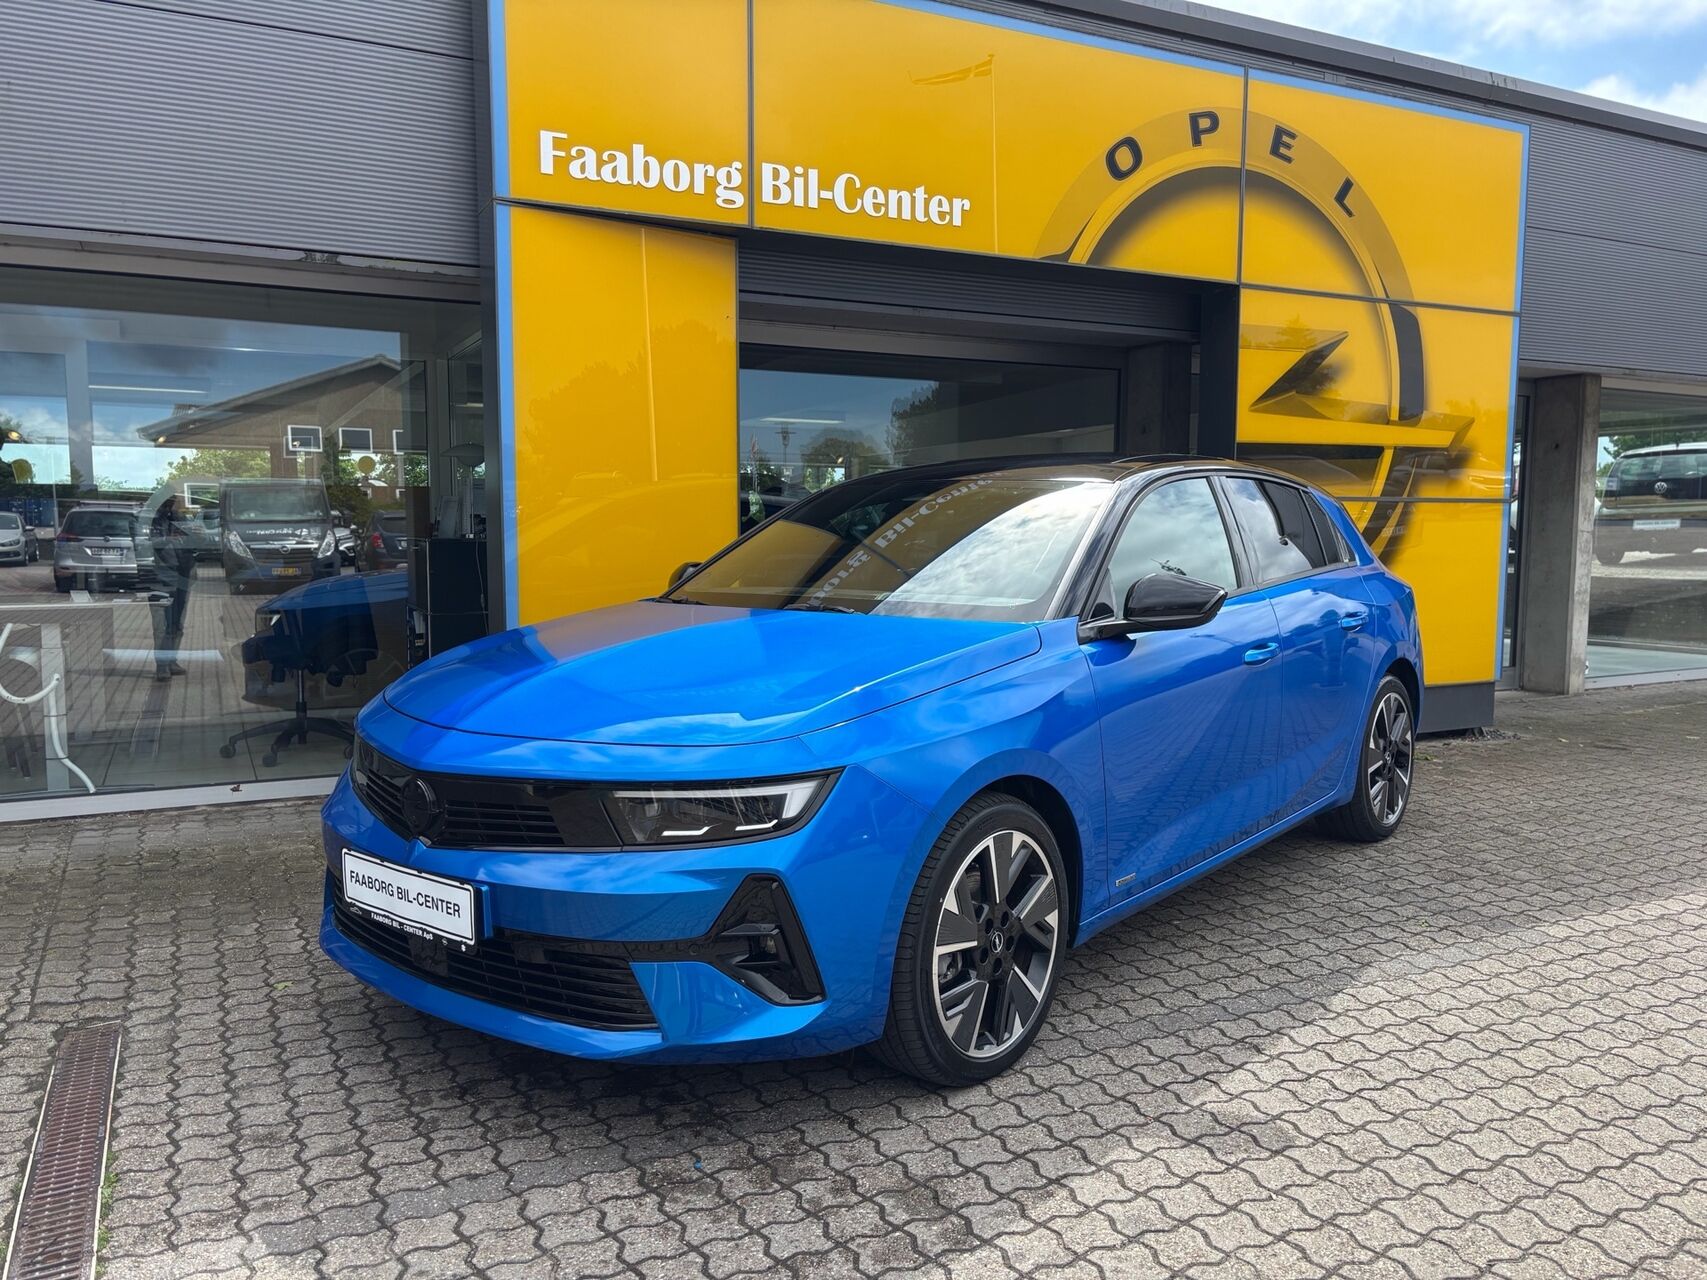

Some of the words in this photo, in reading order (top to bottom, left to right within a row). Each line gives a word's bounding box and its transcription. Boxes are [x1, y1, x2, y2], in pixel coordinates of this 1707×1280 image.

[539, 130, 745, 209] Faaborg
[761, 162, 970, 227] Bil-Center
[1105, 110, 1354, 218] OPEL
[350, 869, 394, 898] FAABORG
[397, 885, 461, 919] BIL-CENTER
[370, 912, 392, 926] FAABORG
[392, 920, 401, 929] BIL
[403, 924, 423, 937] CENTER
